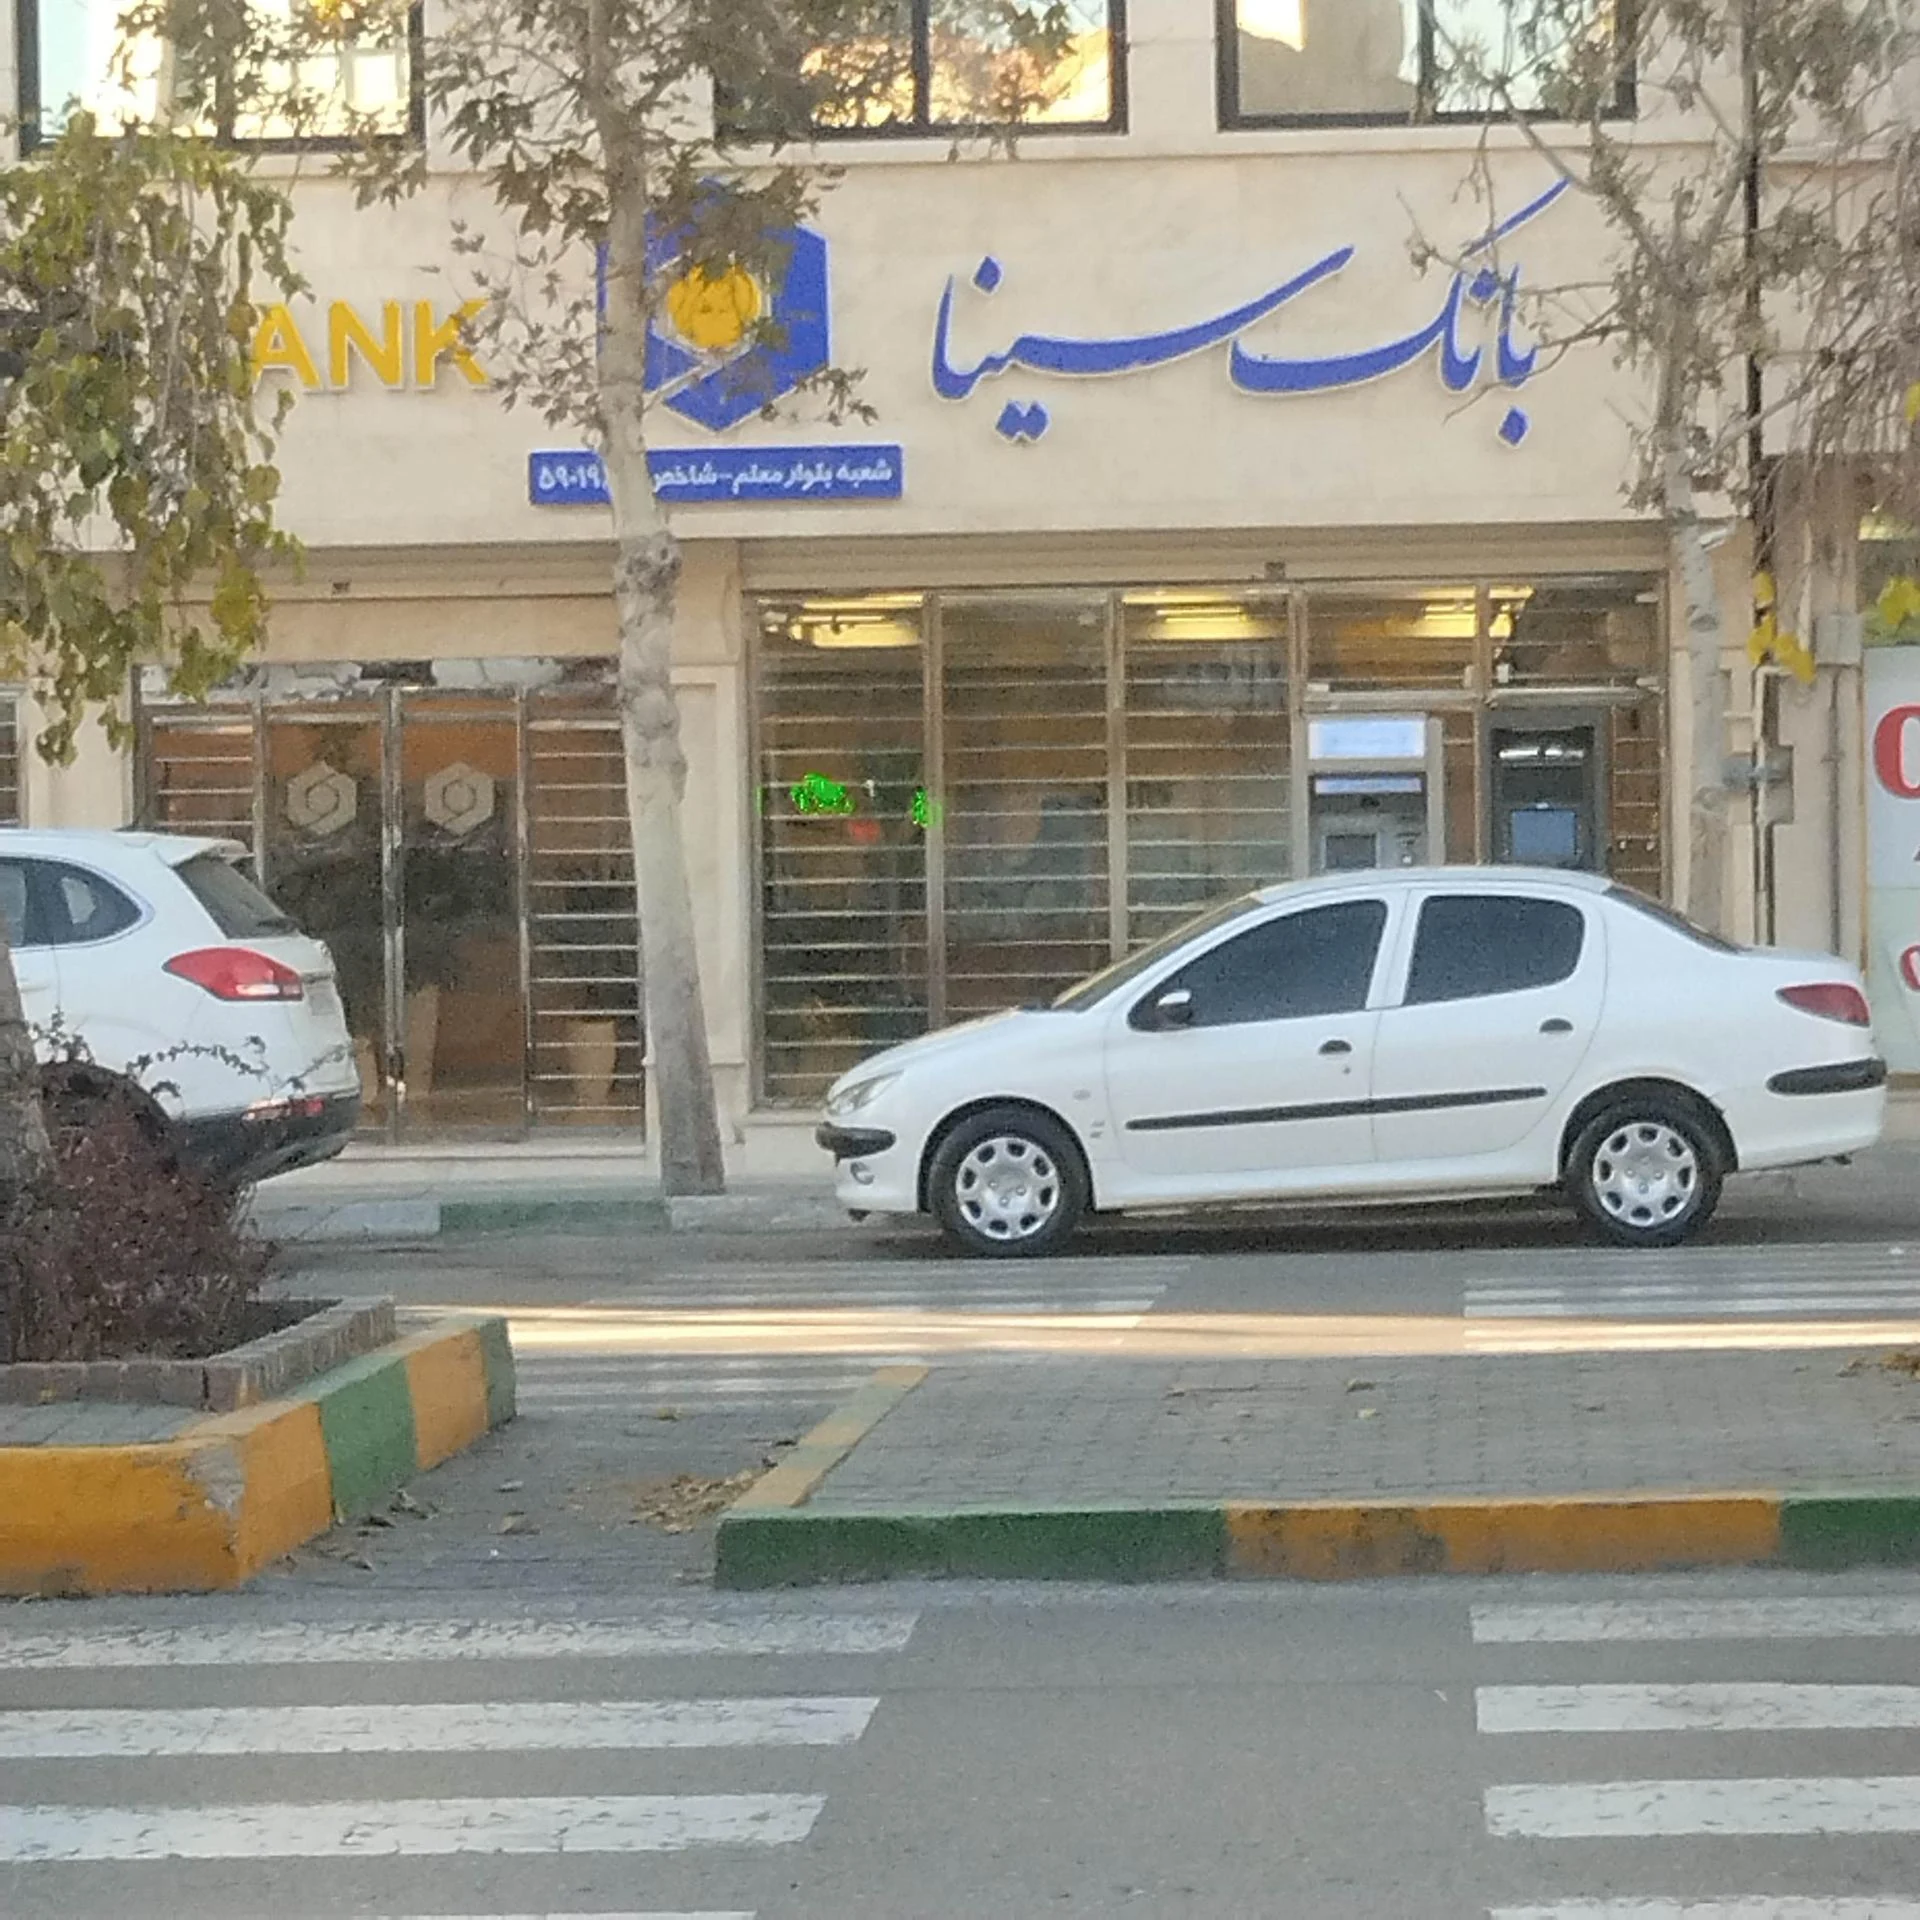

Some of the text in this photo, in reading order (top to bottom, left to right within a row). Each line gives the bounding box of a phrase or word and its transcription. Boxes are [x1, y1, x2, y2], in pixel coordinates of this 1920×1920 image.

[932, 174, 1573, 447] بانک سینا
[249, 298, 490, 386] ANK
[783, 461, 833, 491] بلوار
[836, 458, 893, 489] شعبه
